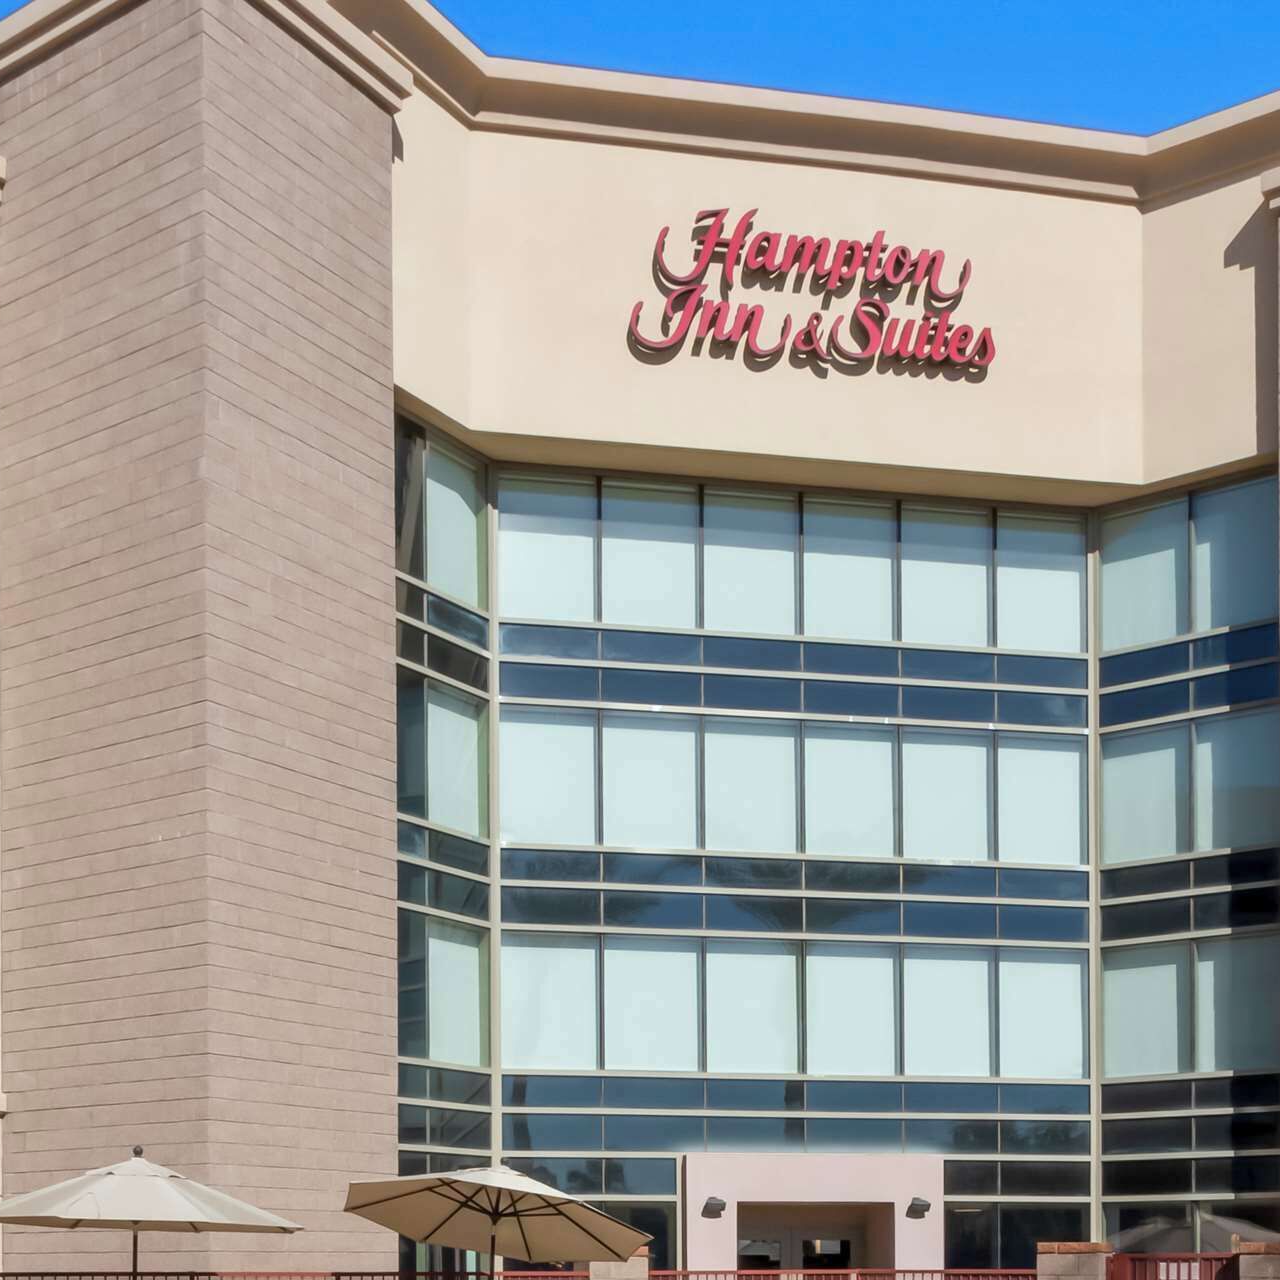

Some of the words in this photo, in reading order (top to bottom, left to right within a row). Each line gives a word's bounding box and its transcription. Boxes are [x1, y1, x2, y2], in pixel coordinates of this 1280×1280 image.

[655, 207, 972, 299] Hampton
[630, 283, 792, 356] Inn
[793, 311, 831, 359] &
[831, 297, 997, 367] Suites
